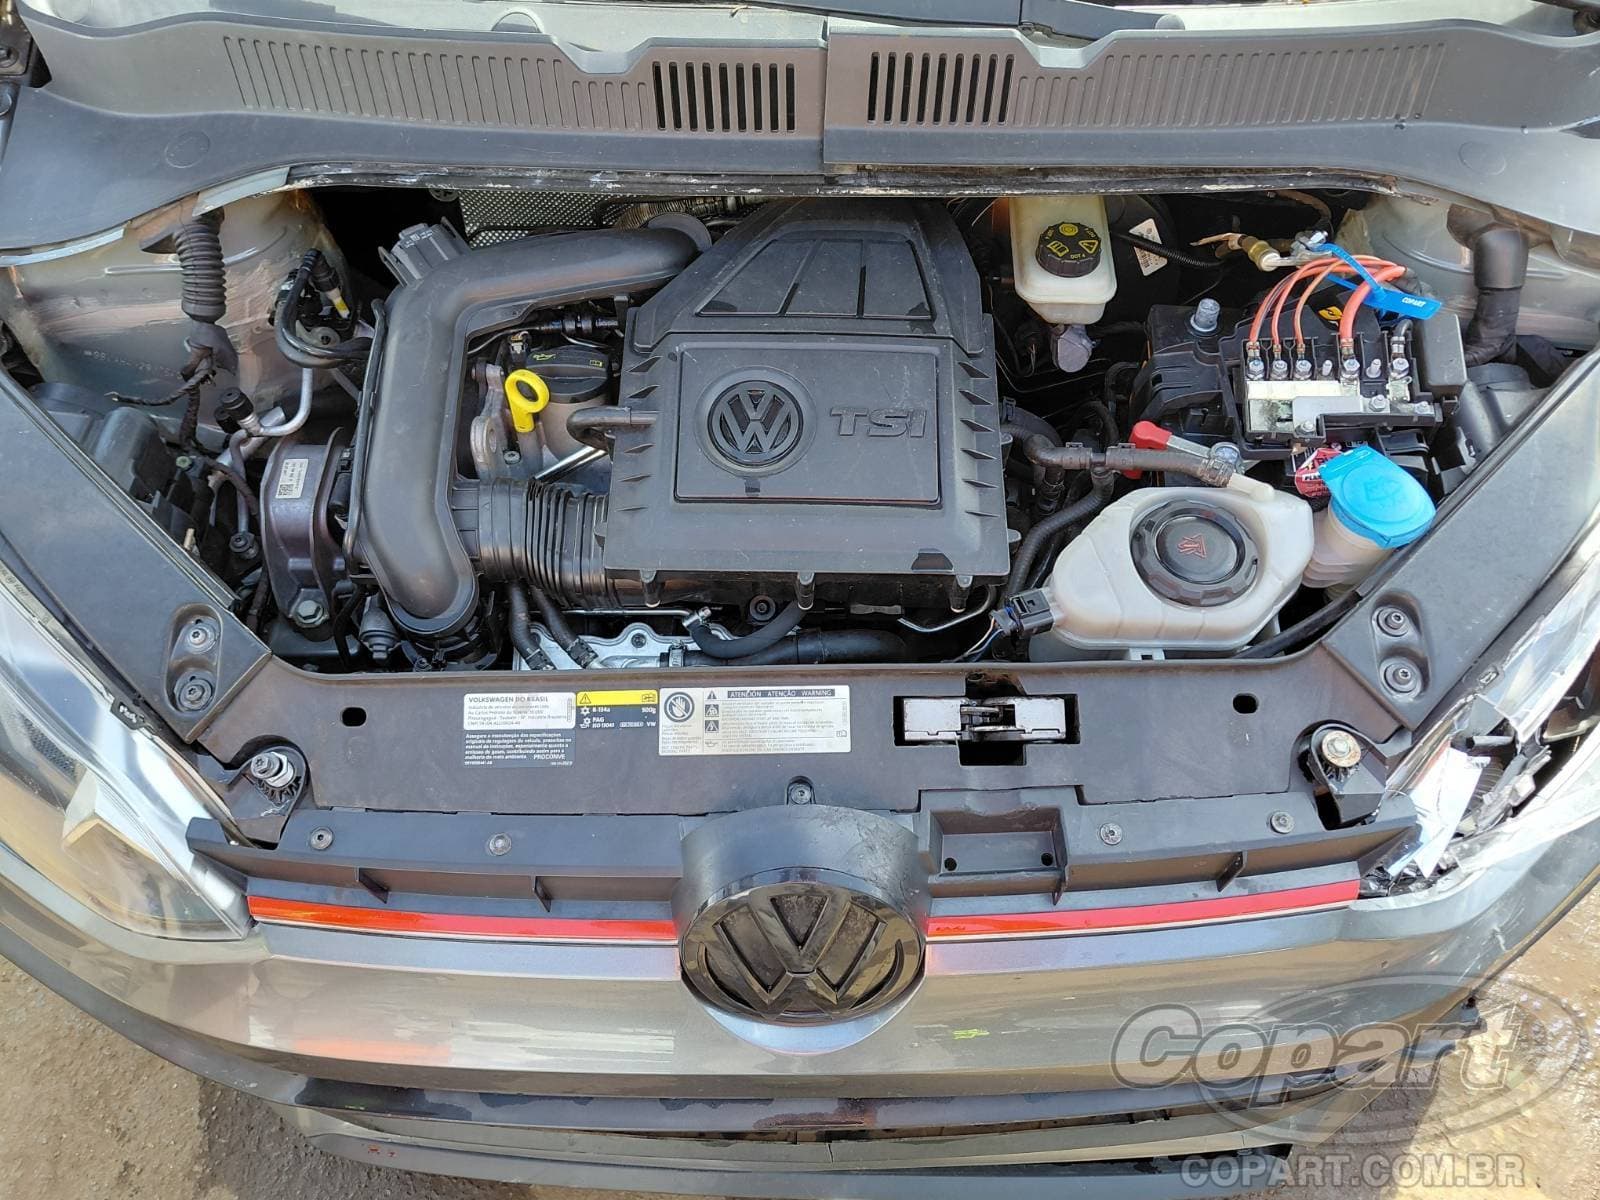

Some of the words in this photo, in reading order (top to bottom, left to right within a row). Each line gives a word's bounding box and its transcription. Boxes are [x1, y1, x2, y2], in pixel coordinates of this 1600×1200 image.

[1402, 296, 1426, 308] COPART
[830, 407, 927, 438] TSI
[767, 690, 796, 698] ATENÇÃO
[802, 688, 832, 697] WARNING
